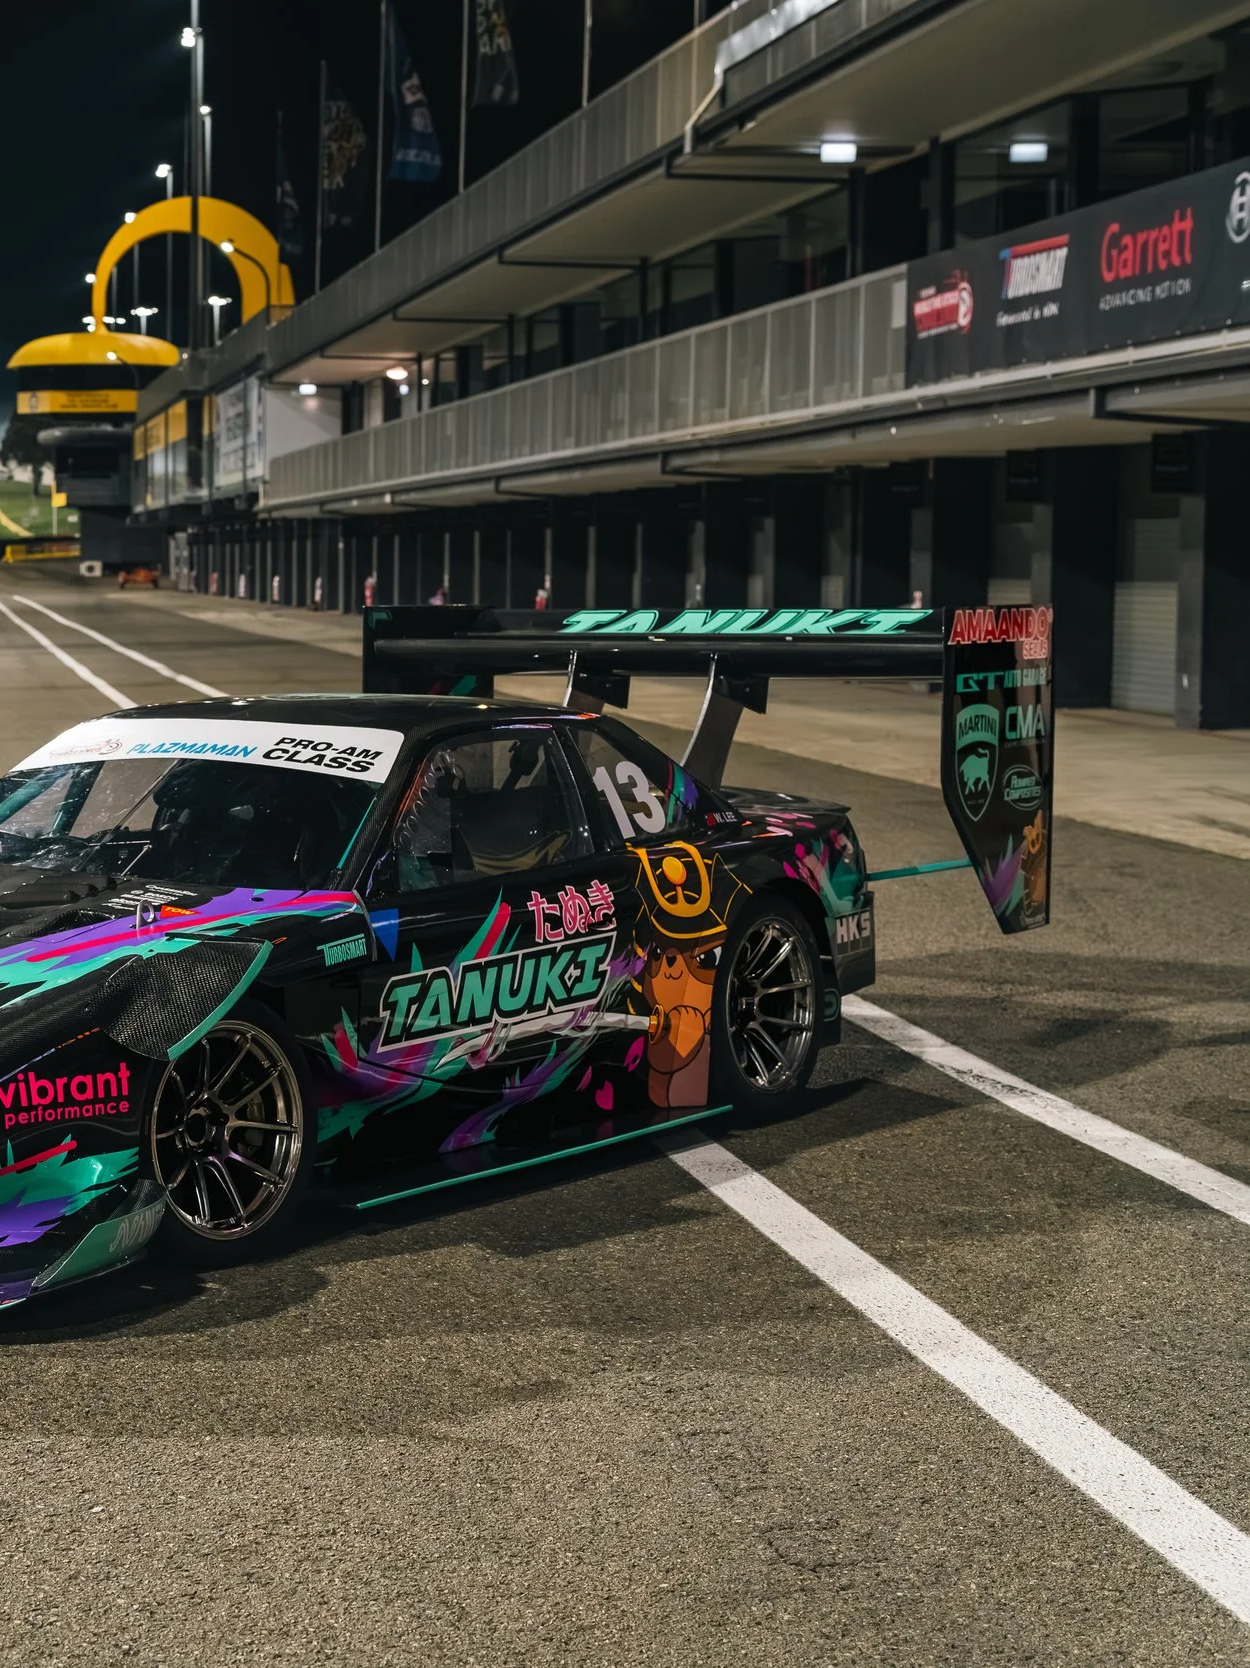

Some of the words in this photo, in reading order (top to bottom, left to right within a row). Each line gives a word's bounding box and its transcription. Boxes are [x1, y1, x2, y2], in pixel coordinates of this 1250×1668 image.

[1101, 207, 1194, 283] Garrett
[1099, 286, 1153, 311] ADVANCING
[1154, 278, 1192, 300] MOTION
[559, 609, 933, 634] TANUKI
[947, 607, 1051, 645] AMAANDO
[956, 671, 1004, 693] GT
[958, 714, 997, 740] MARTINI
[1005, 704, 1045, 739] CMA
[126, 742, 258, 758] PLAZMAMAN
[262, 747, 375, 773] CLASS
[274, 736, 384, 761] PRO-AM
[592, 761, 666, 839] 13
[165, 906, 196, 915] TOW
[527, 879, 617, 943] たぬき
[836, 911, 871, 944] HKS
[383, 939, 611, 1044] TANUKI
[4, 1101, 130, 1130] performance
